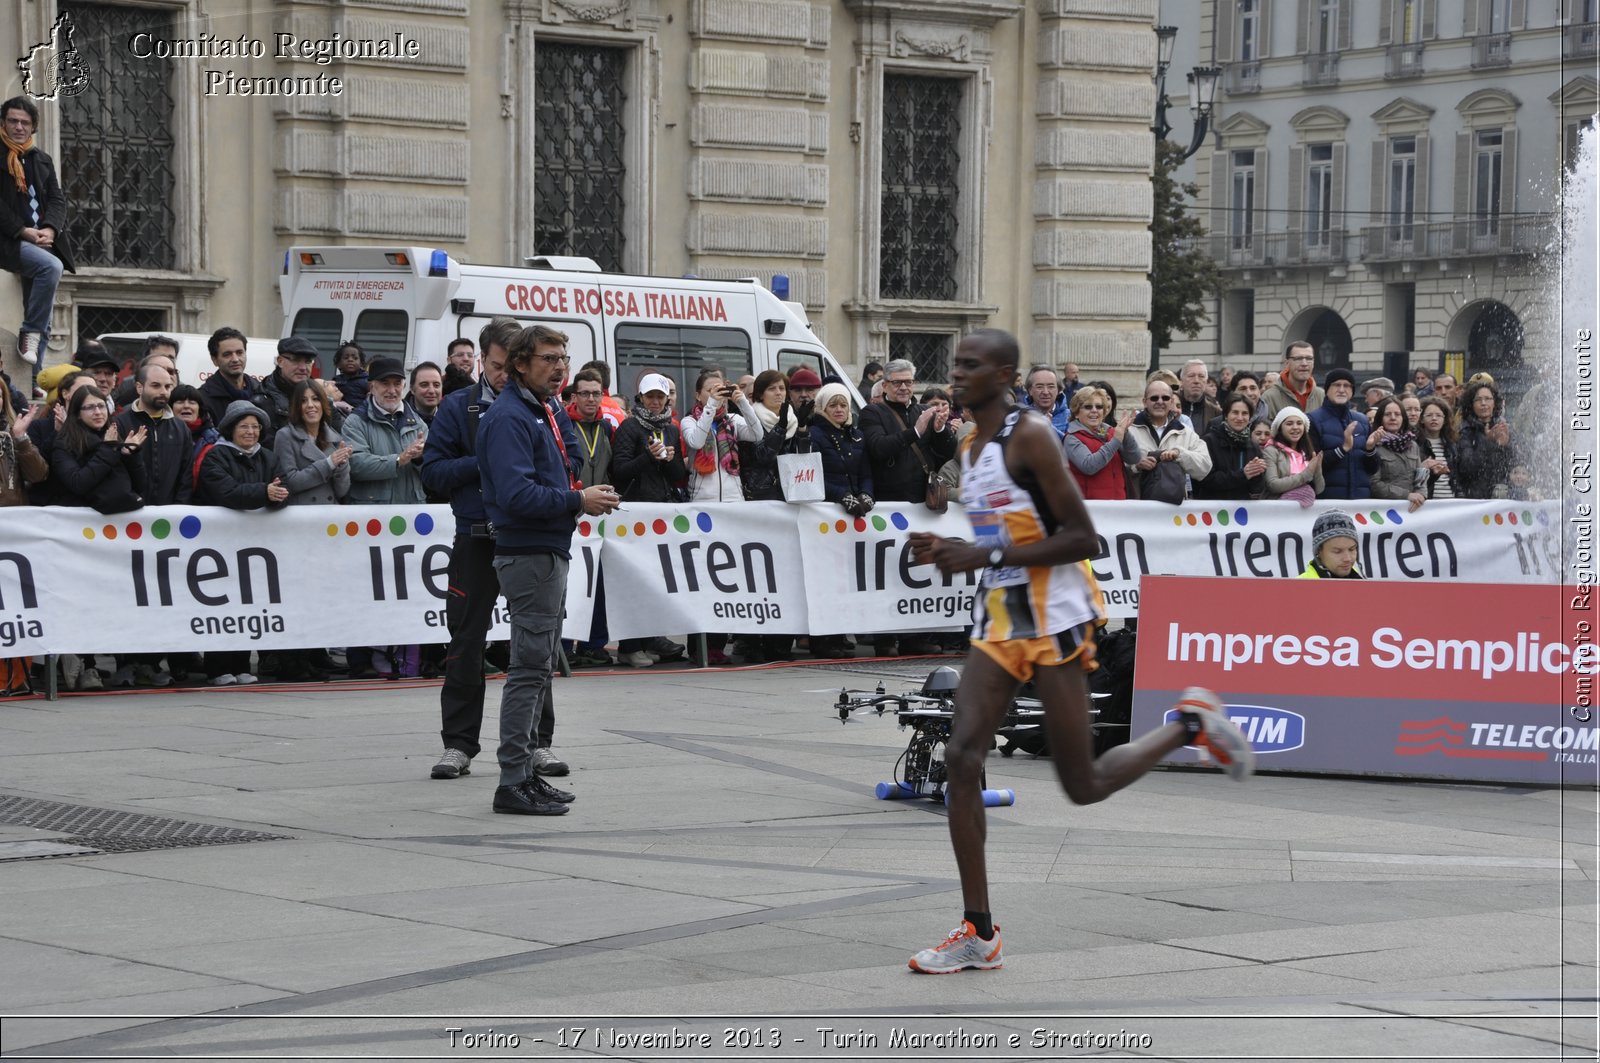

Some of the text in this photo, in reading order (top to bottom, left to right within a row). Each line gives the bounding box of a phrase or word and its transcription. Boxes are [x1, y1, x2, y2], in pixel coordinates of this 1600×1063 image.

[346, 280, 354, 290] DI
[355, 281, 405, 291] EMERGENZA
[353, 291, 384, 301] MOBILE
[504, 283, 728, 322] CROCE ROSSA ITALIANA
[657, 540, 778, 594] iren
[1209, 531, 1306, 578] iren
[1362, 531, 1459, 579] iren
[131, 546, 282, 607] iren
[368, 543, 450, 602] ire
[713, 597, 782, 625] energia
[897, 590, 976, 618] energia
[190, 608, 286, 640] energia
[1167, 622, 1600, 680] Impresa Semplice
[1230, 715, 1288, 744] TIM
[1471, 722, 1600, 751] TELECOM
[1554, 752, 1597, 764] ITALIA
